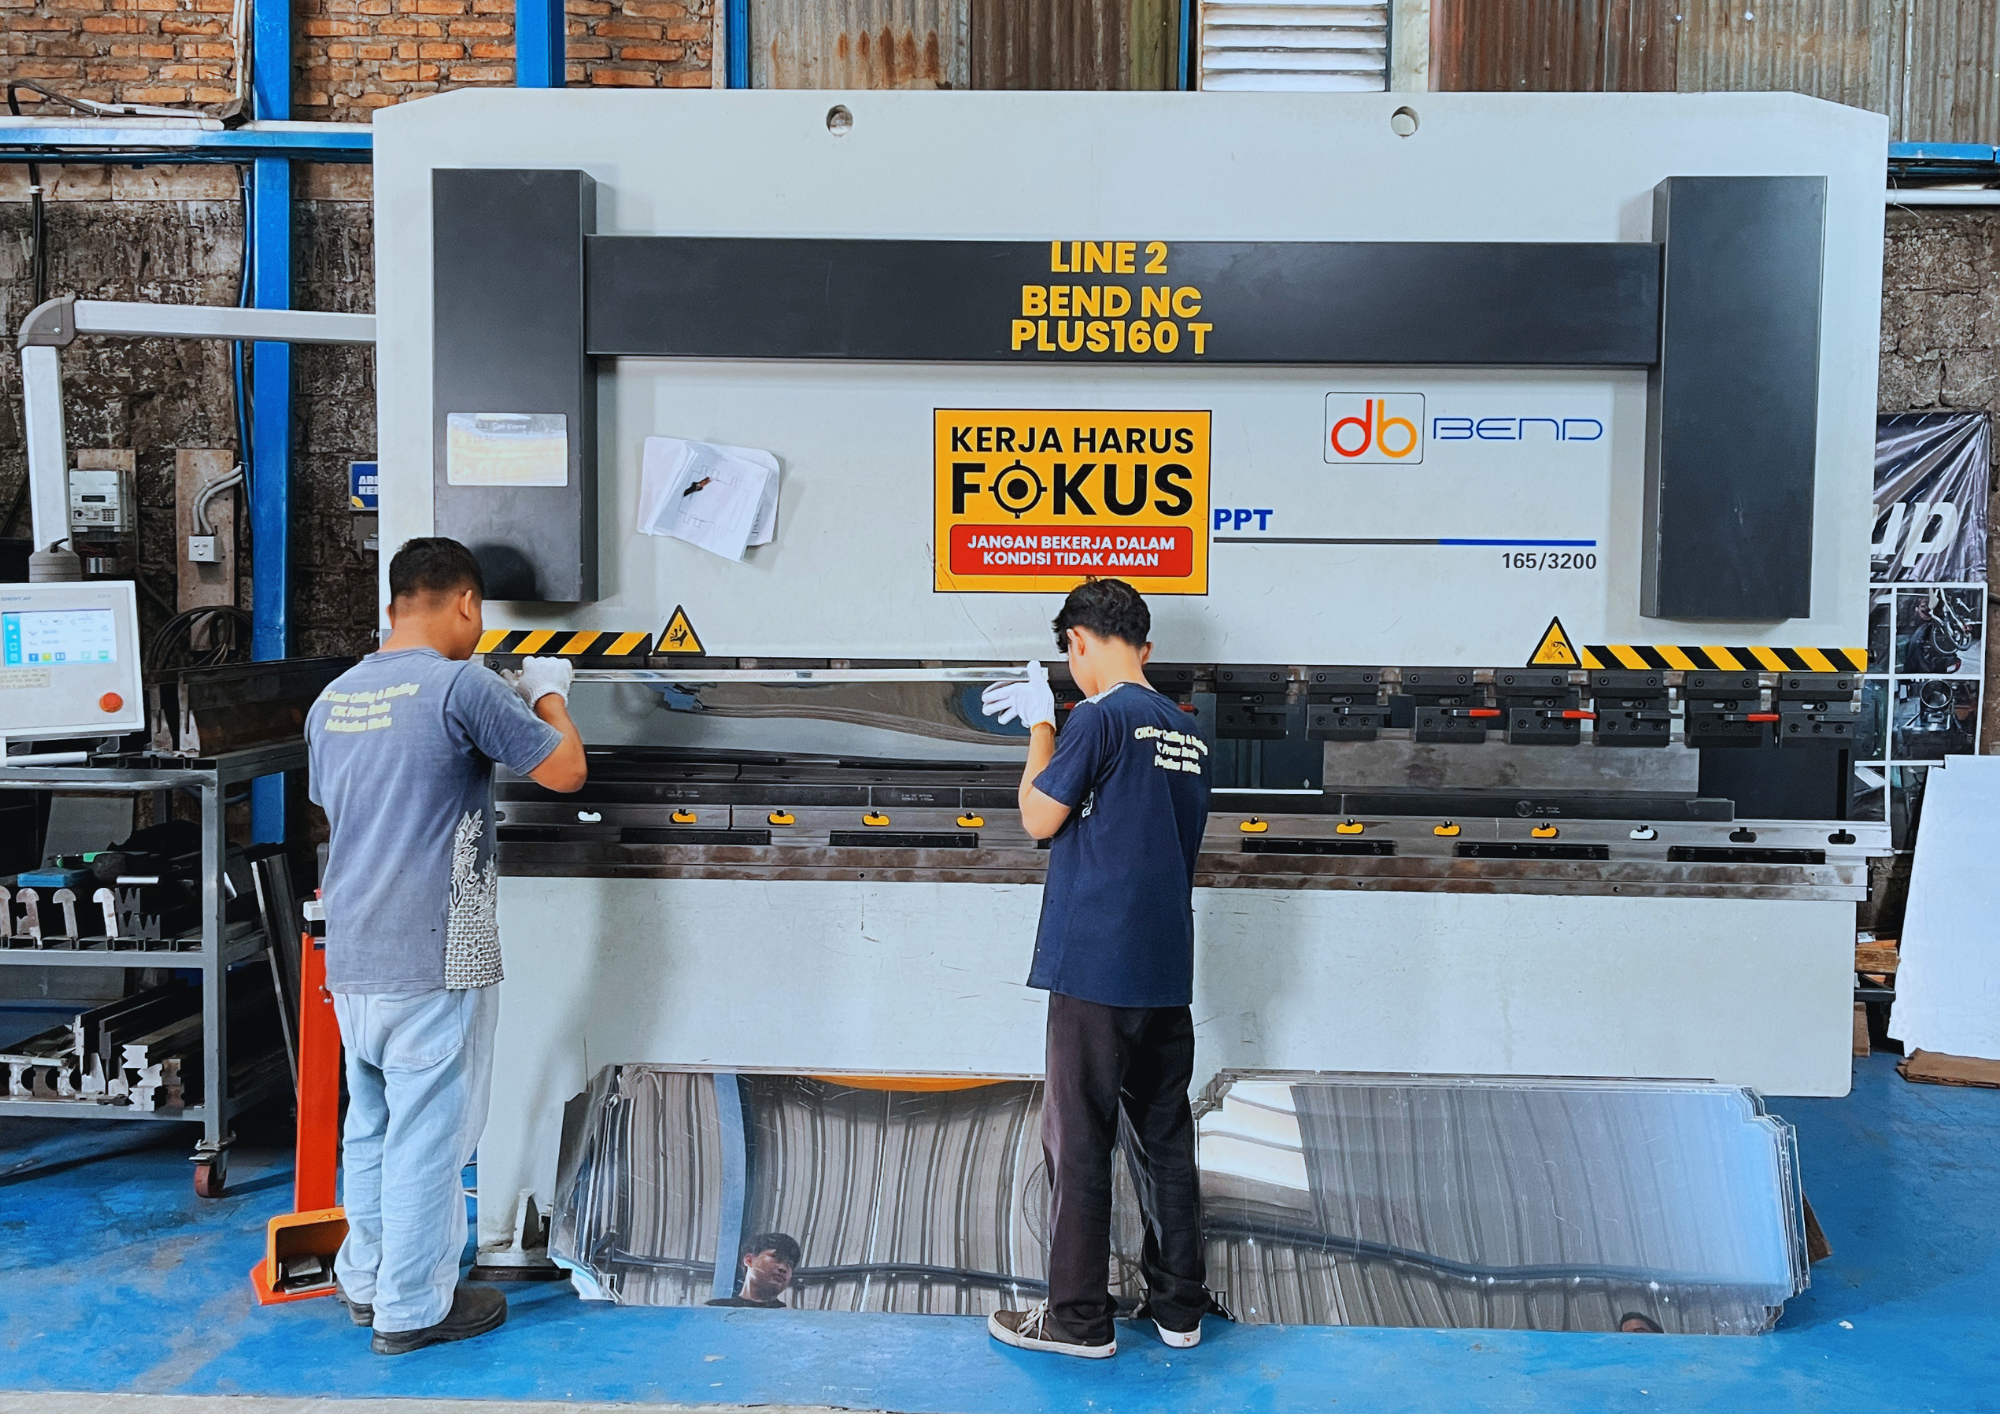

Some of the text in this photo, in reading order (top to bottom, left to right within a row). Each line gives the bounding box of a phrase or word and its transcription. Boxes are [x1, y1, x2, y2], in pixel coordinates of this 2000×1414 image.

[1050, 241, 1168, 275] LINE 2
[1021, 285, 1202, 318] BEND NC
[1011, 319, 1213, 355] PLUS160 T
[951, 426, 1194, 454] KERJA HARUS
[1433, 417, 1604, 441] BEND
[952, 459, 1193, 519] FOKUS
[1214, 508, 1274, 531] PPT
[967, 535, 1175, 551] JANGAN BEKERJA DALAM
[983, 552, 1159, 567] KONDISI TIDAK AMAN
[1502, 552, 1597, 571] 165/3200
